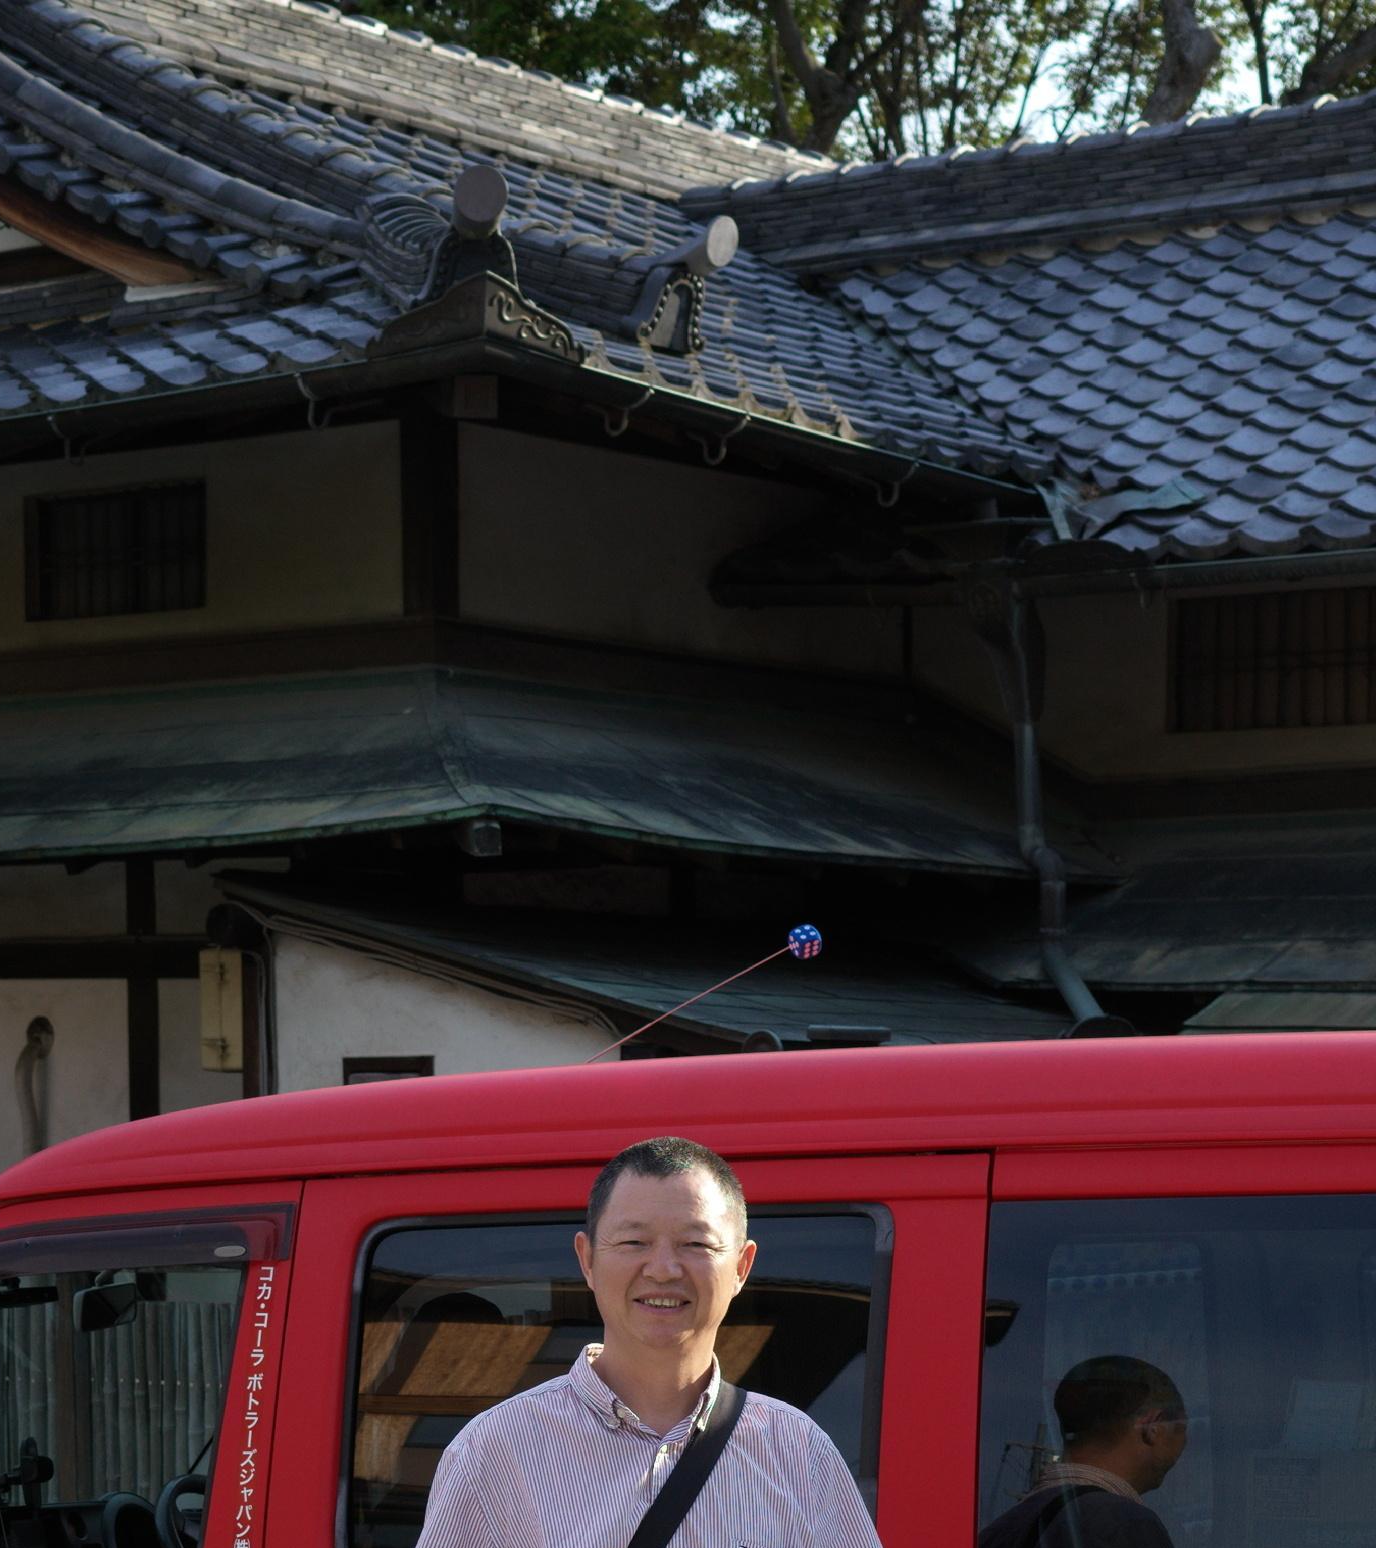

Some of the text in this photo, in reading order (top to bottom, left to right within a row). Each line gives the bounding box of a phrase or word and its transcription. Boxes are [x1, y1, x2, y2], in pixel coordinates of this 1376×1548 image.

[250, 1265, 275, 1367] コカ・コーラ
